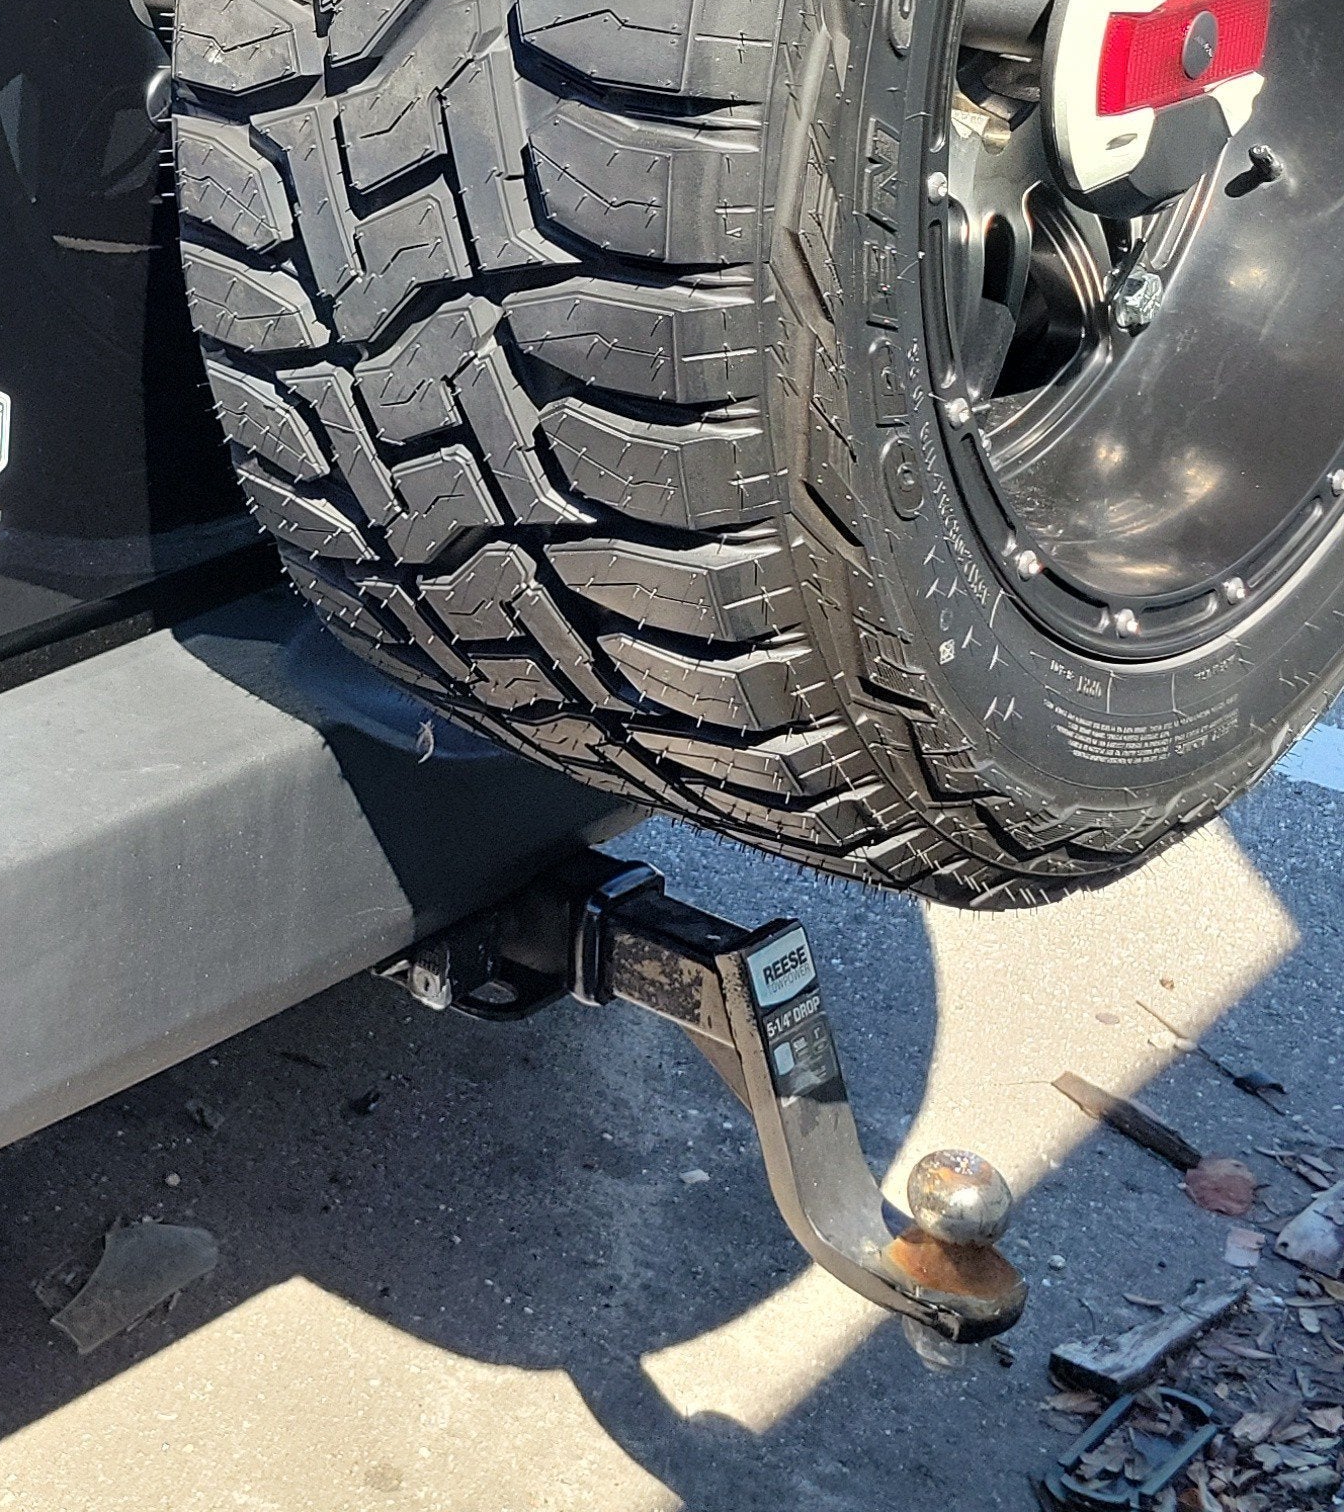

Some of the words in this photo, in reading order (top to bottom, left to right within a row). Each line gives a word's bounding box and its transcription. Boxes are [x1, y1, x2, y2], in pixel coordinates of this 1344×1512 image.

[861, 112, 926, 520] OPEN
[762, 945, 808, 986] REESE
[793, 995, 821, 1027] DROP
